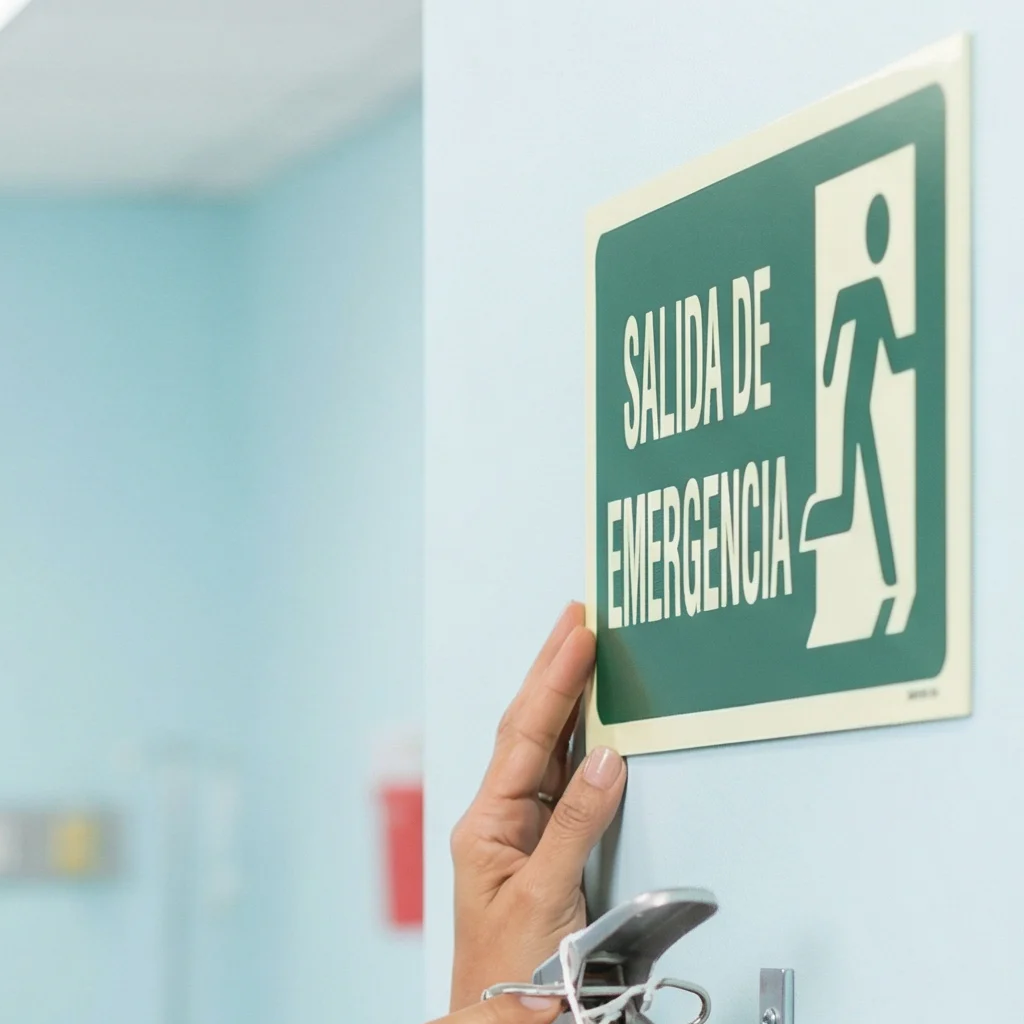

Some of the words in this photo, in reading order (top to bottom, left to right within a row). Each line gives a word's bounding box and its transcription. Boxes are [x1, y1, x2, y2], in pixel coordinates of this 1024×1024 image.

[623, 286, 724, 450] SALIDA
[732, 265, 771, 416] DE
[607, 456, 793, 629] EMERGENCIA
